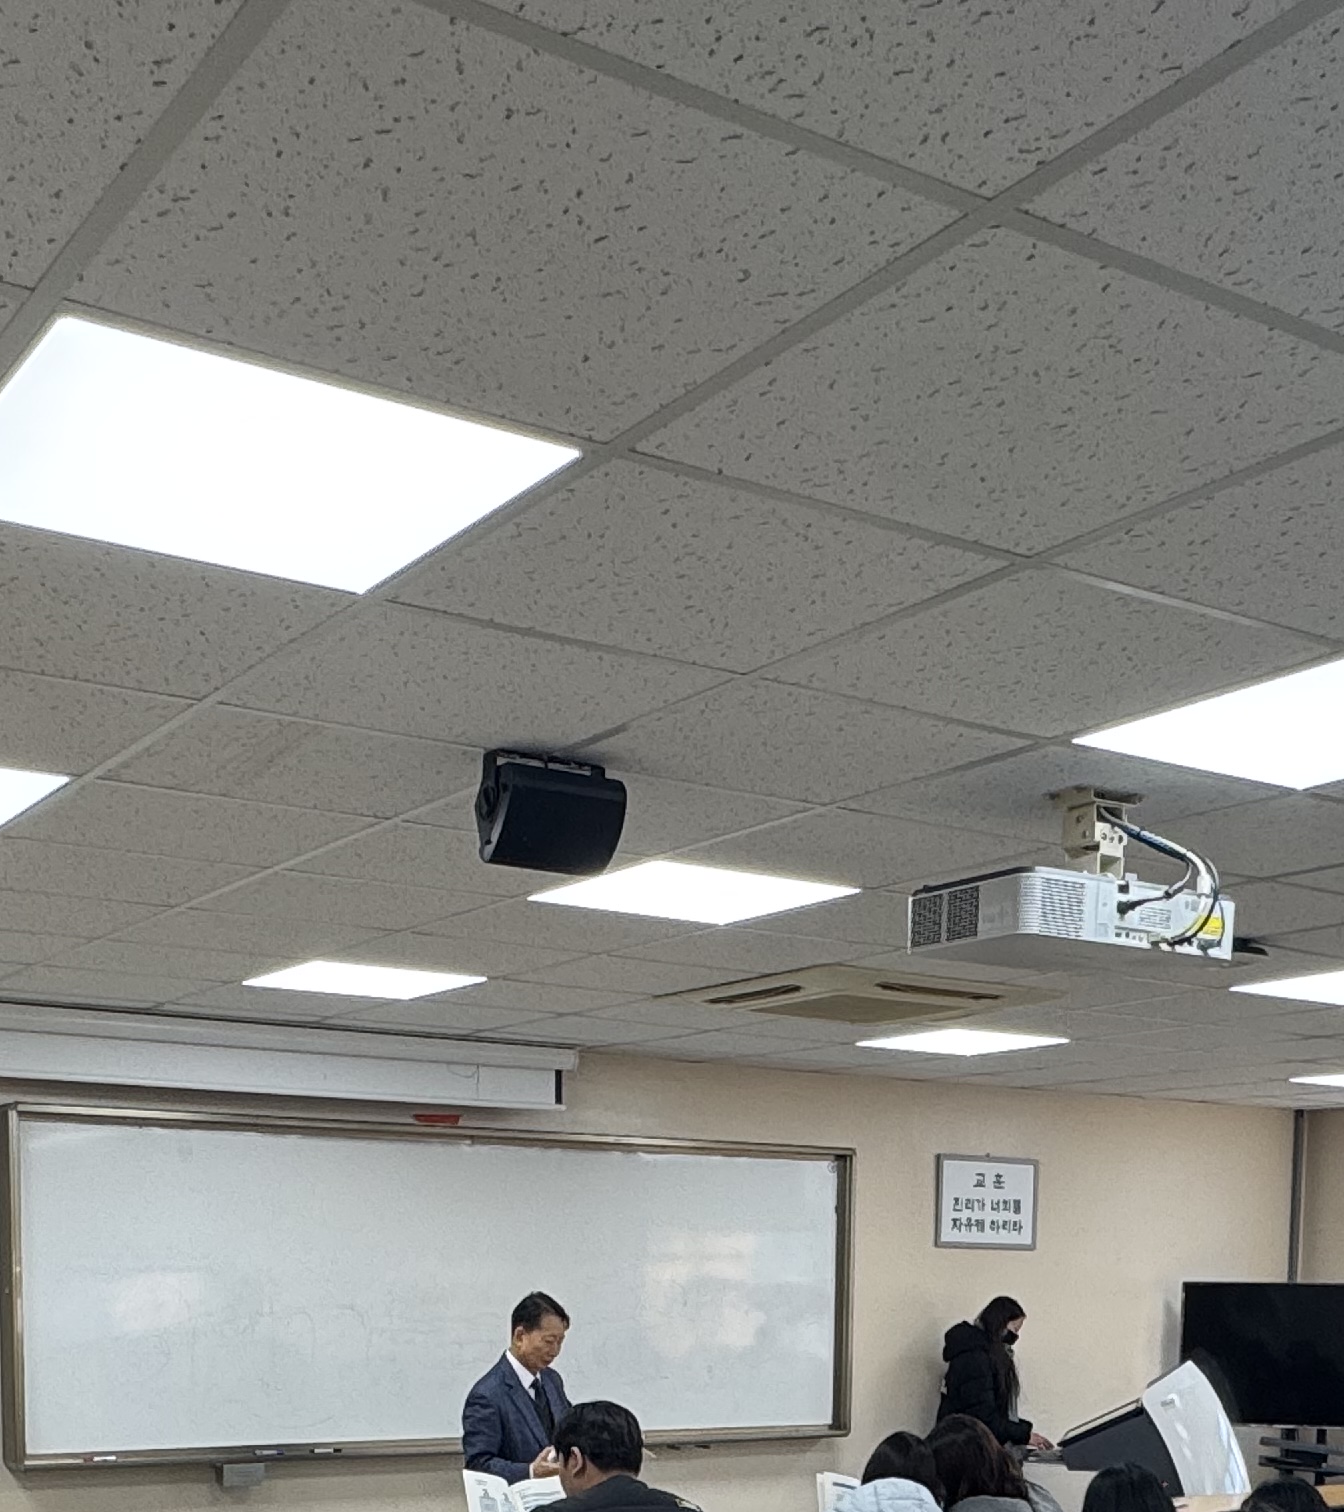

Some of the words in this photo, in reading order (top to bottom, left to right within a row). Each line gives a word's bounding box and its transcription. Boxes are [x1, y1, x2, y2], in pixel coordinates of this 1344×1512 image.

[952, 1197, 986, 1213] 진리가
[990, 1198, 1022, 1215] 너희를
[989, 1219, 1023, 1235] 하리라
